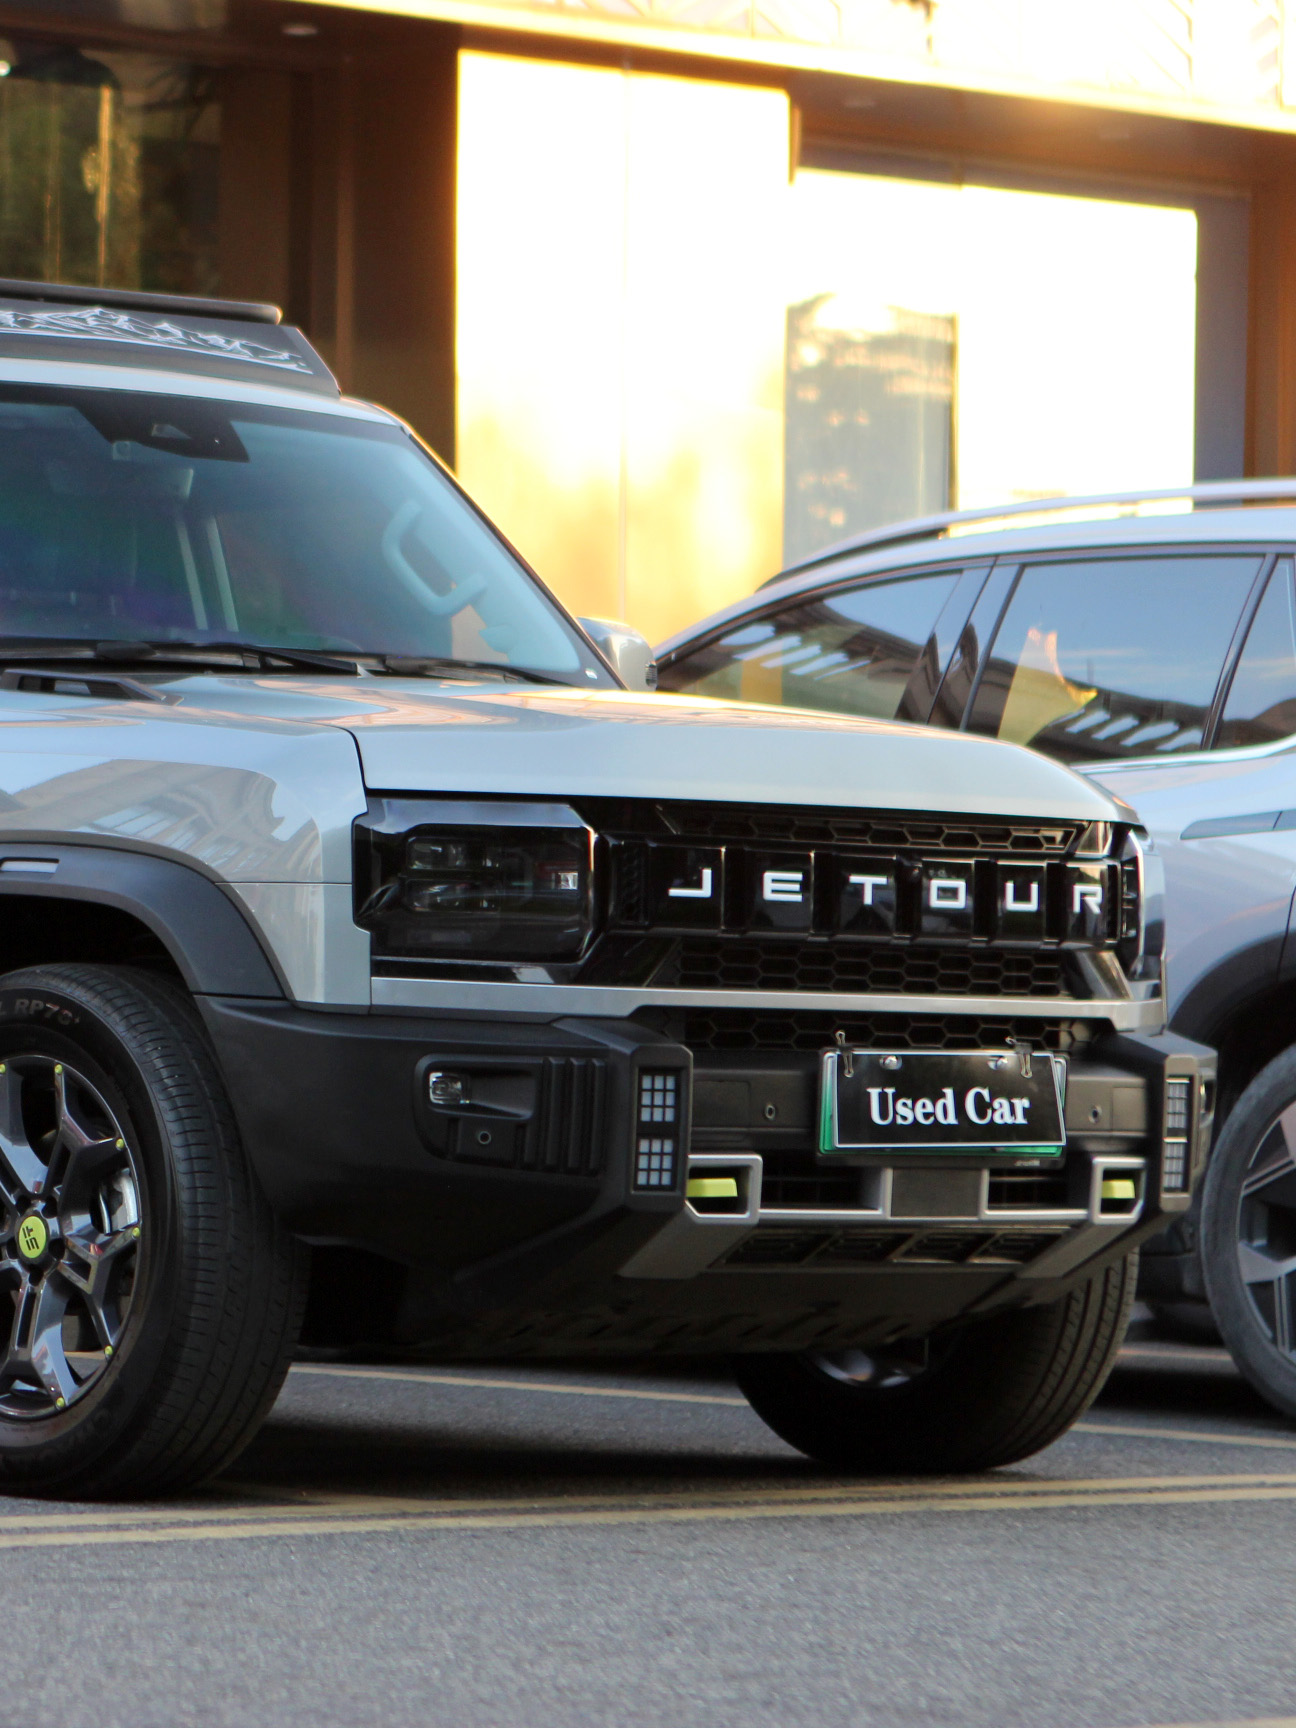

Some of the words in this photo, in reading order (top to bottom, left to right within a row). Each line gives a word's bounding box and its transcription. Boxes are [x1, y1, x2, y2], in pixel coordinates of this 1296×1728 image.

[667, 867, 1105, 917] JETOUR
[868, 1087, 955, 1126] Used
[964, 1089, 1030, 1126] Car
